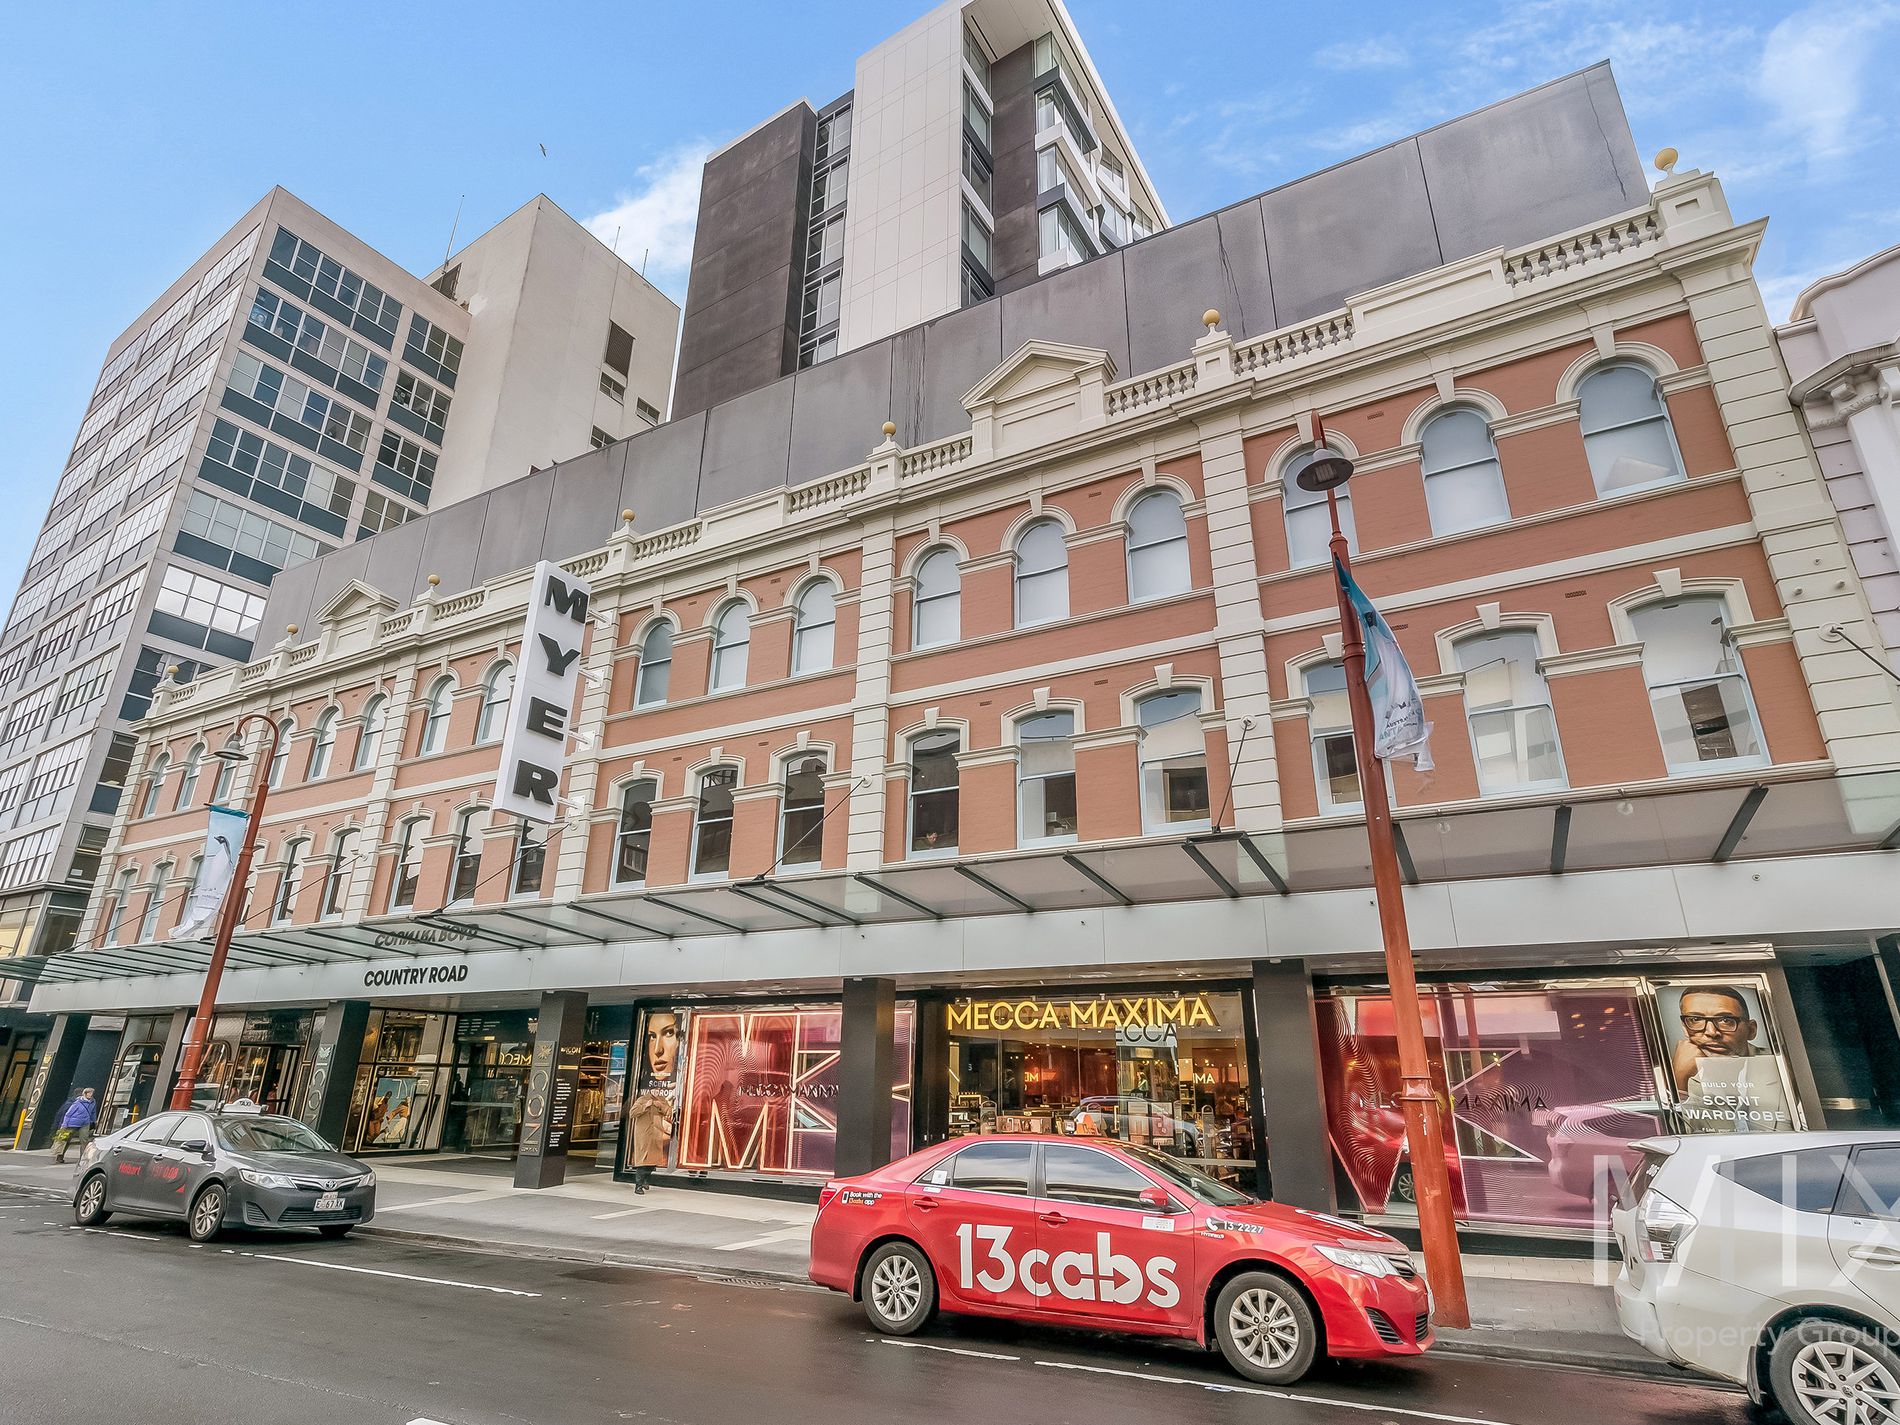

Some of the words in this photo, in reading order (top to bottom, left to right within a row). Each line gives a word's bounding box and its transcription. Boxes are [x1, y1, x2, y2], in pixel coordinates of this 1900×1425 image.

[512, 575, 589, 806] MYER
[364, 967, 428, 987] COUNTRY
[428, 964, 468, 984] ROAD
[947, 1001, 1060, 1030] MECCA
[1070, 997, 1214, 1028] MAXIMA
[25, 1066, 48, 1122] ICON
[523, 1062, 549, 1145] ICON
[1702, 1095, 1760, 1106] SCENT
[1685, 1108, 1786, 1121] WARDROBE
[1223, 1220, 1234, 1231] 13
[1237, 1222, 1264, 1234] 2227
[955, 1223, 1181, 1308] 13cabs
